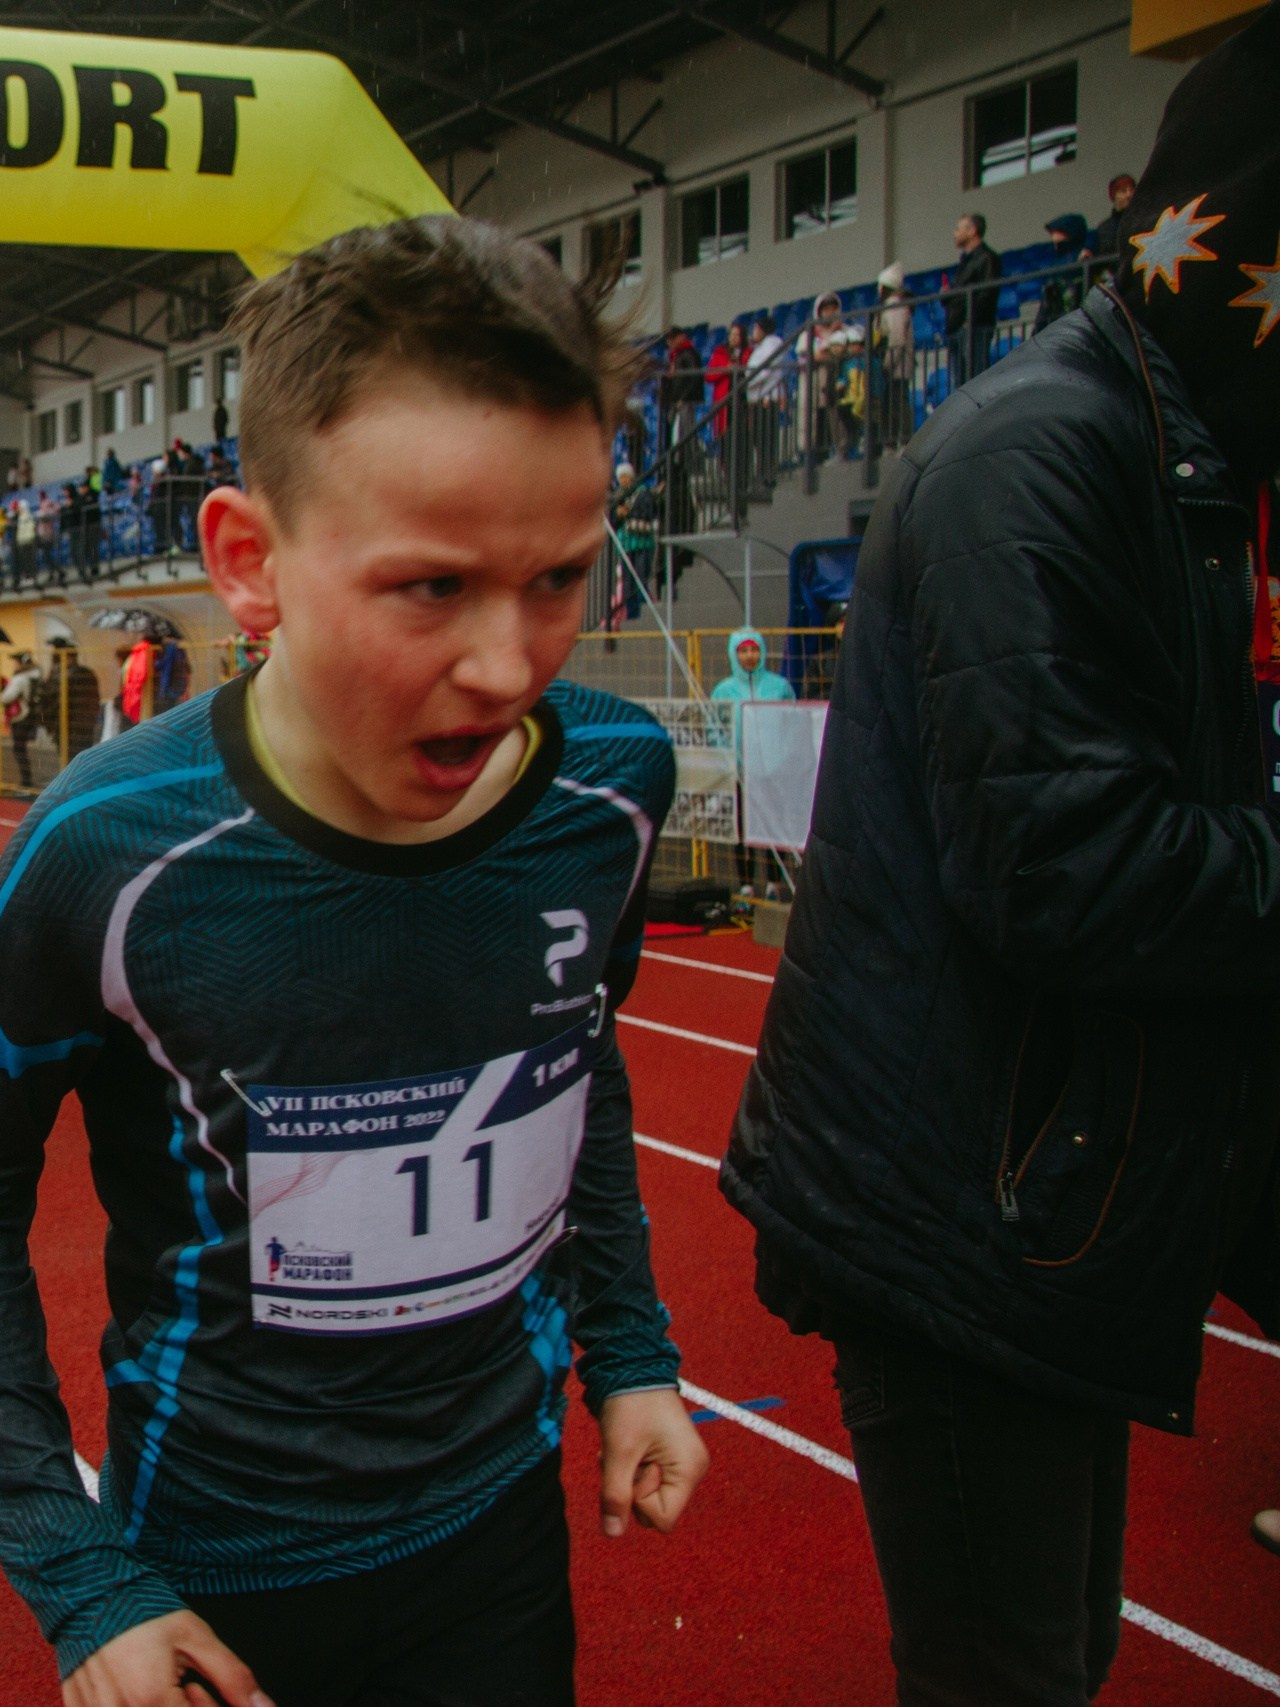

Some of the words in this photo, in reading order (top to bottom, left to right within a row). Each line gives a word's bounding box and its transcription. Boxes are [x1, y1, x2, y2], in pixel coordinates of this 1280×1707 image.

[310, 1076, 467, 1112] ПСКОВСКИЙ
[265, 1114, 400, 1137] МАРАФОН
[402, 1109, 447, 1128] 2022
[395, 1139, 495, 1237] 11
[282, 1267, 353, 1281] МАРАФОН
